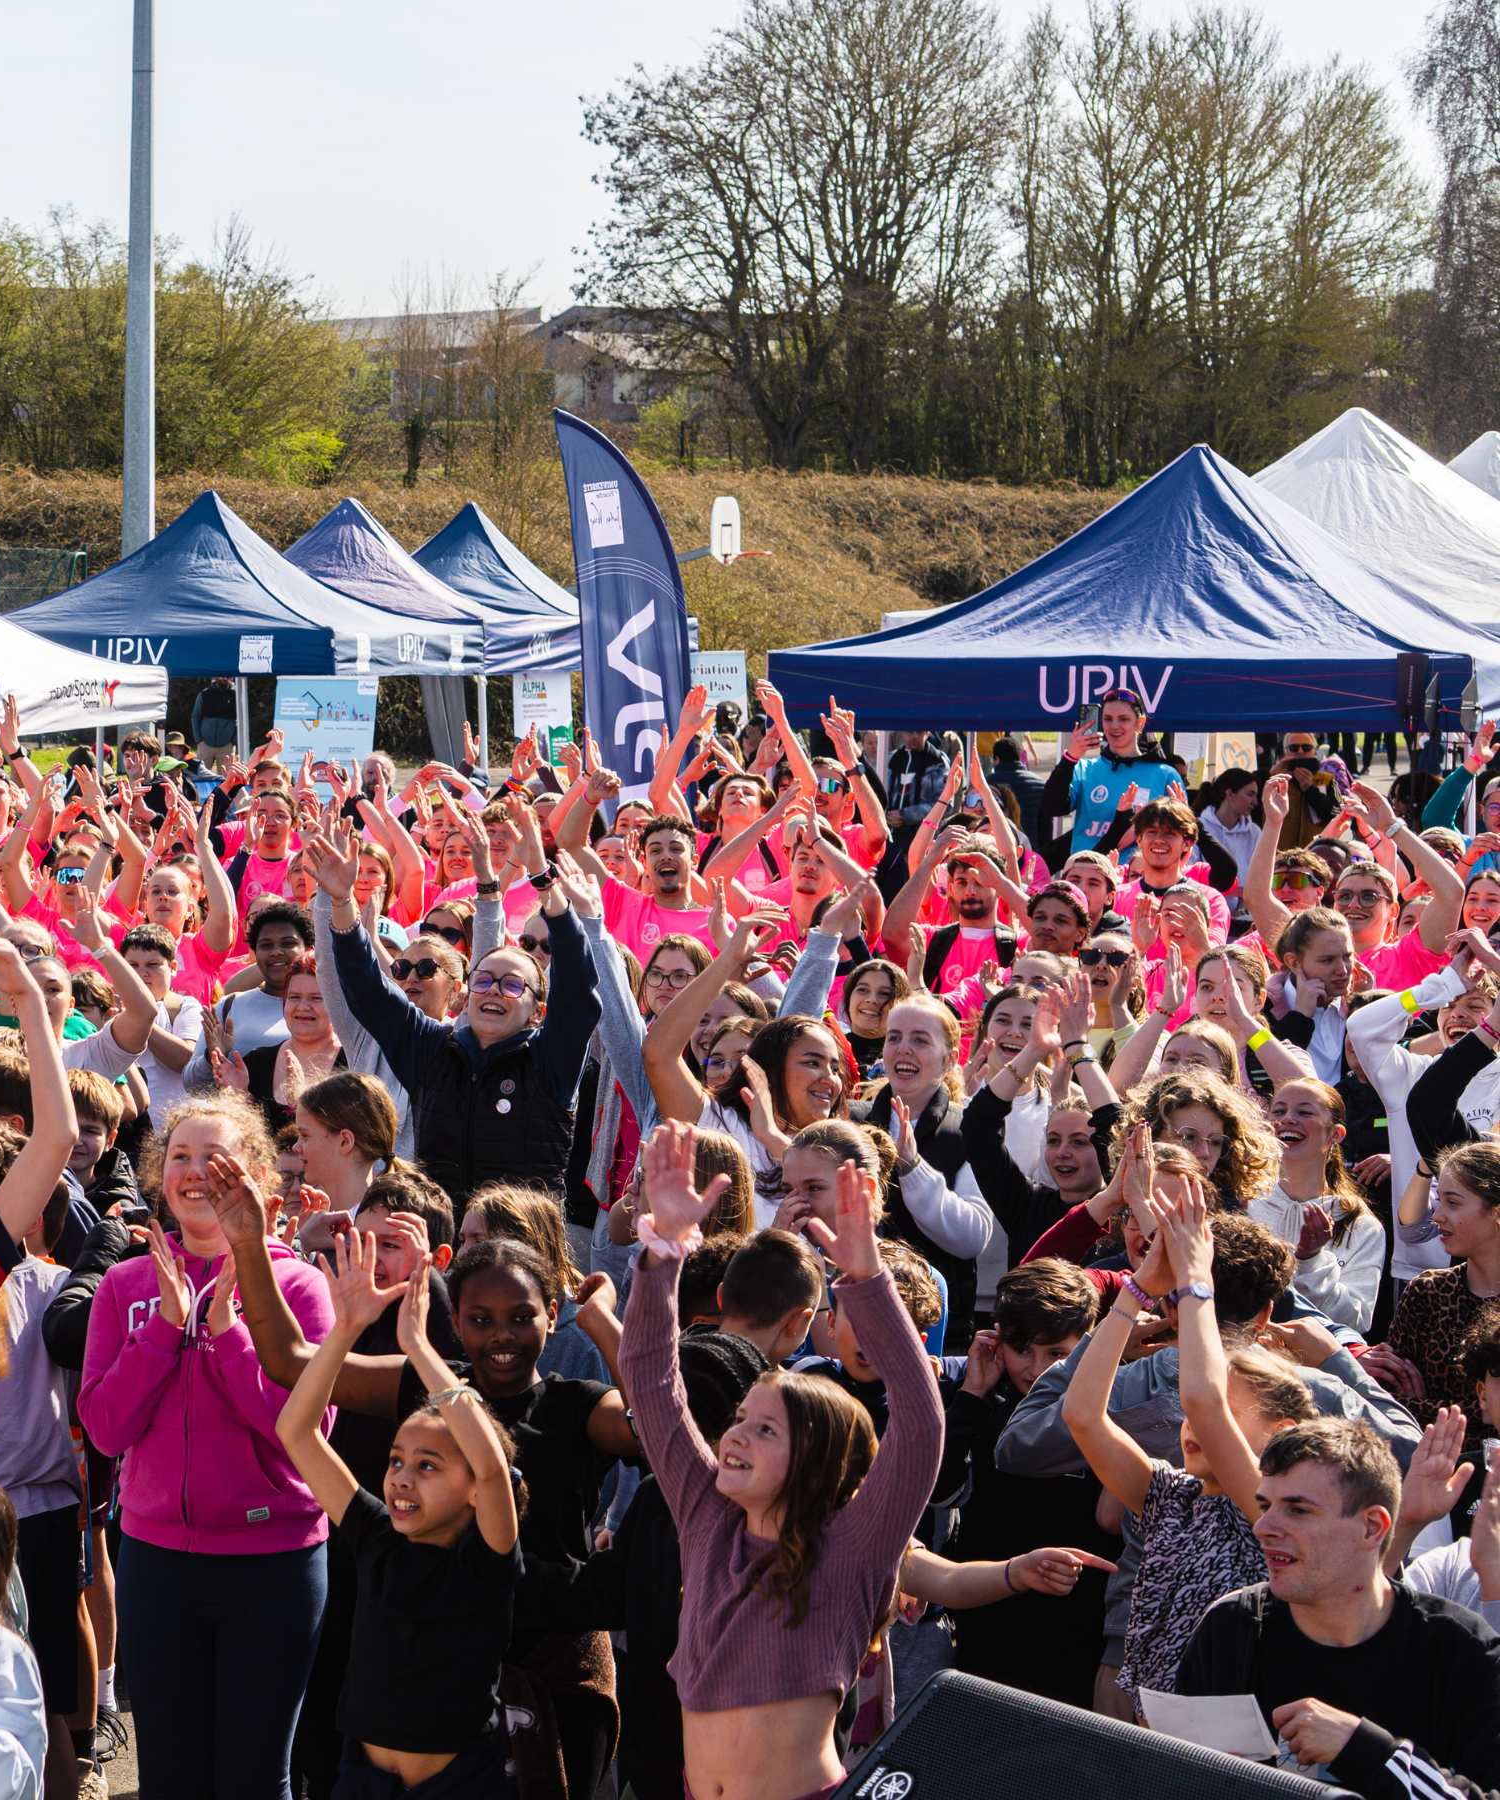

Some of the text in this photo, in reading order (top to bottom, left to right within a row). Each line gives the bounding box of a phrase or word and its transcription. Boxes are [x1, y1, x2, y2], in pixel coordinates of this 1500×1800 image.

[91, 638, 169, 665] UPJV
[397, 634, 428, 663] UPJV
[690, 663, 738, 675] ciation
[522, 681, 546, 693] ALPHA
[709, 680, 732, 691] Pas
[855, 1766, 886, 1797] YAMAHA
